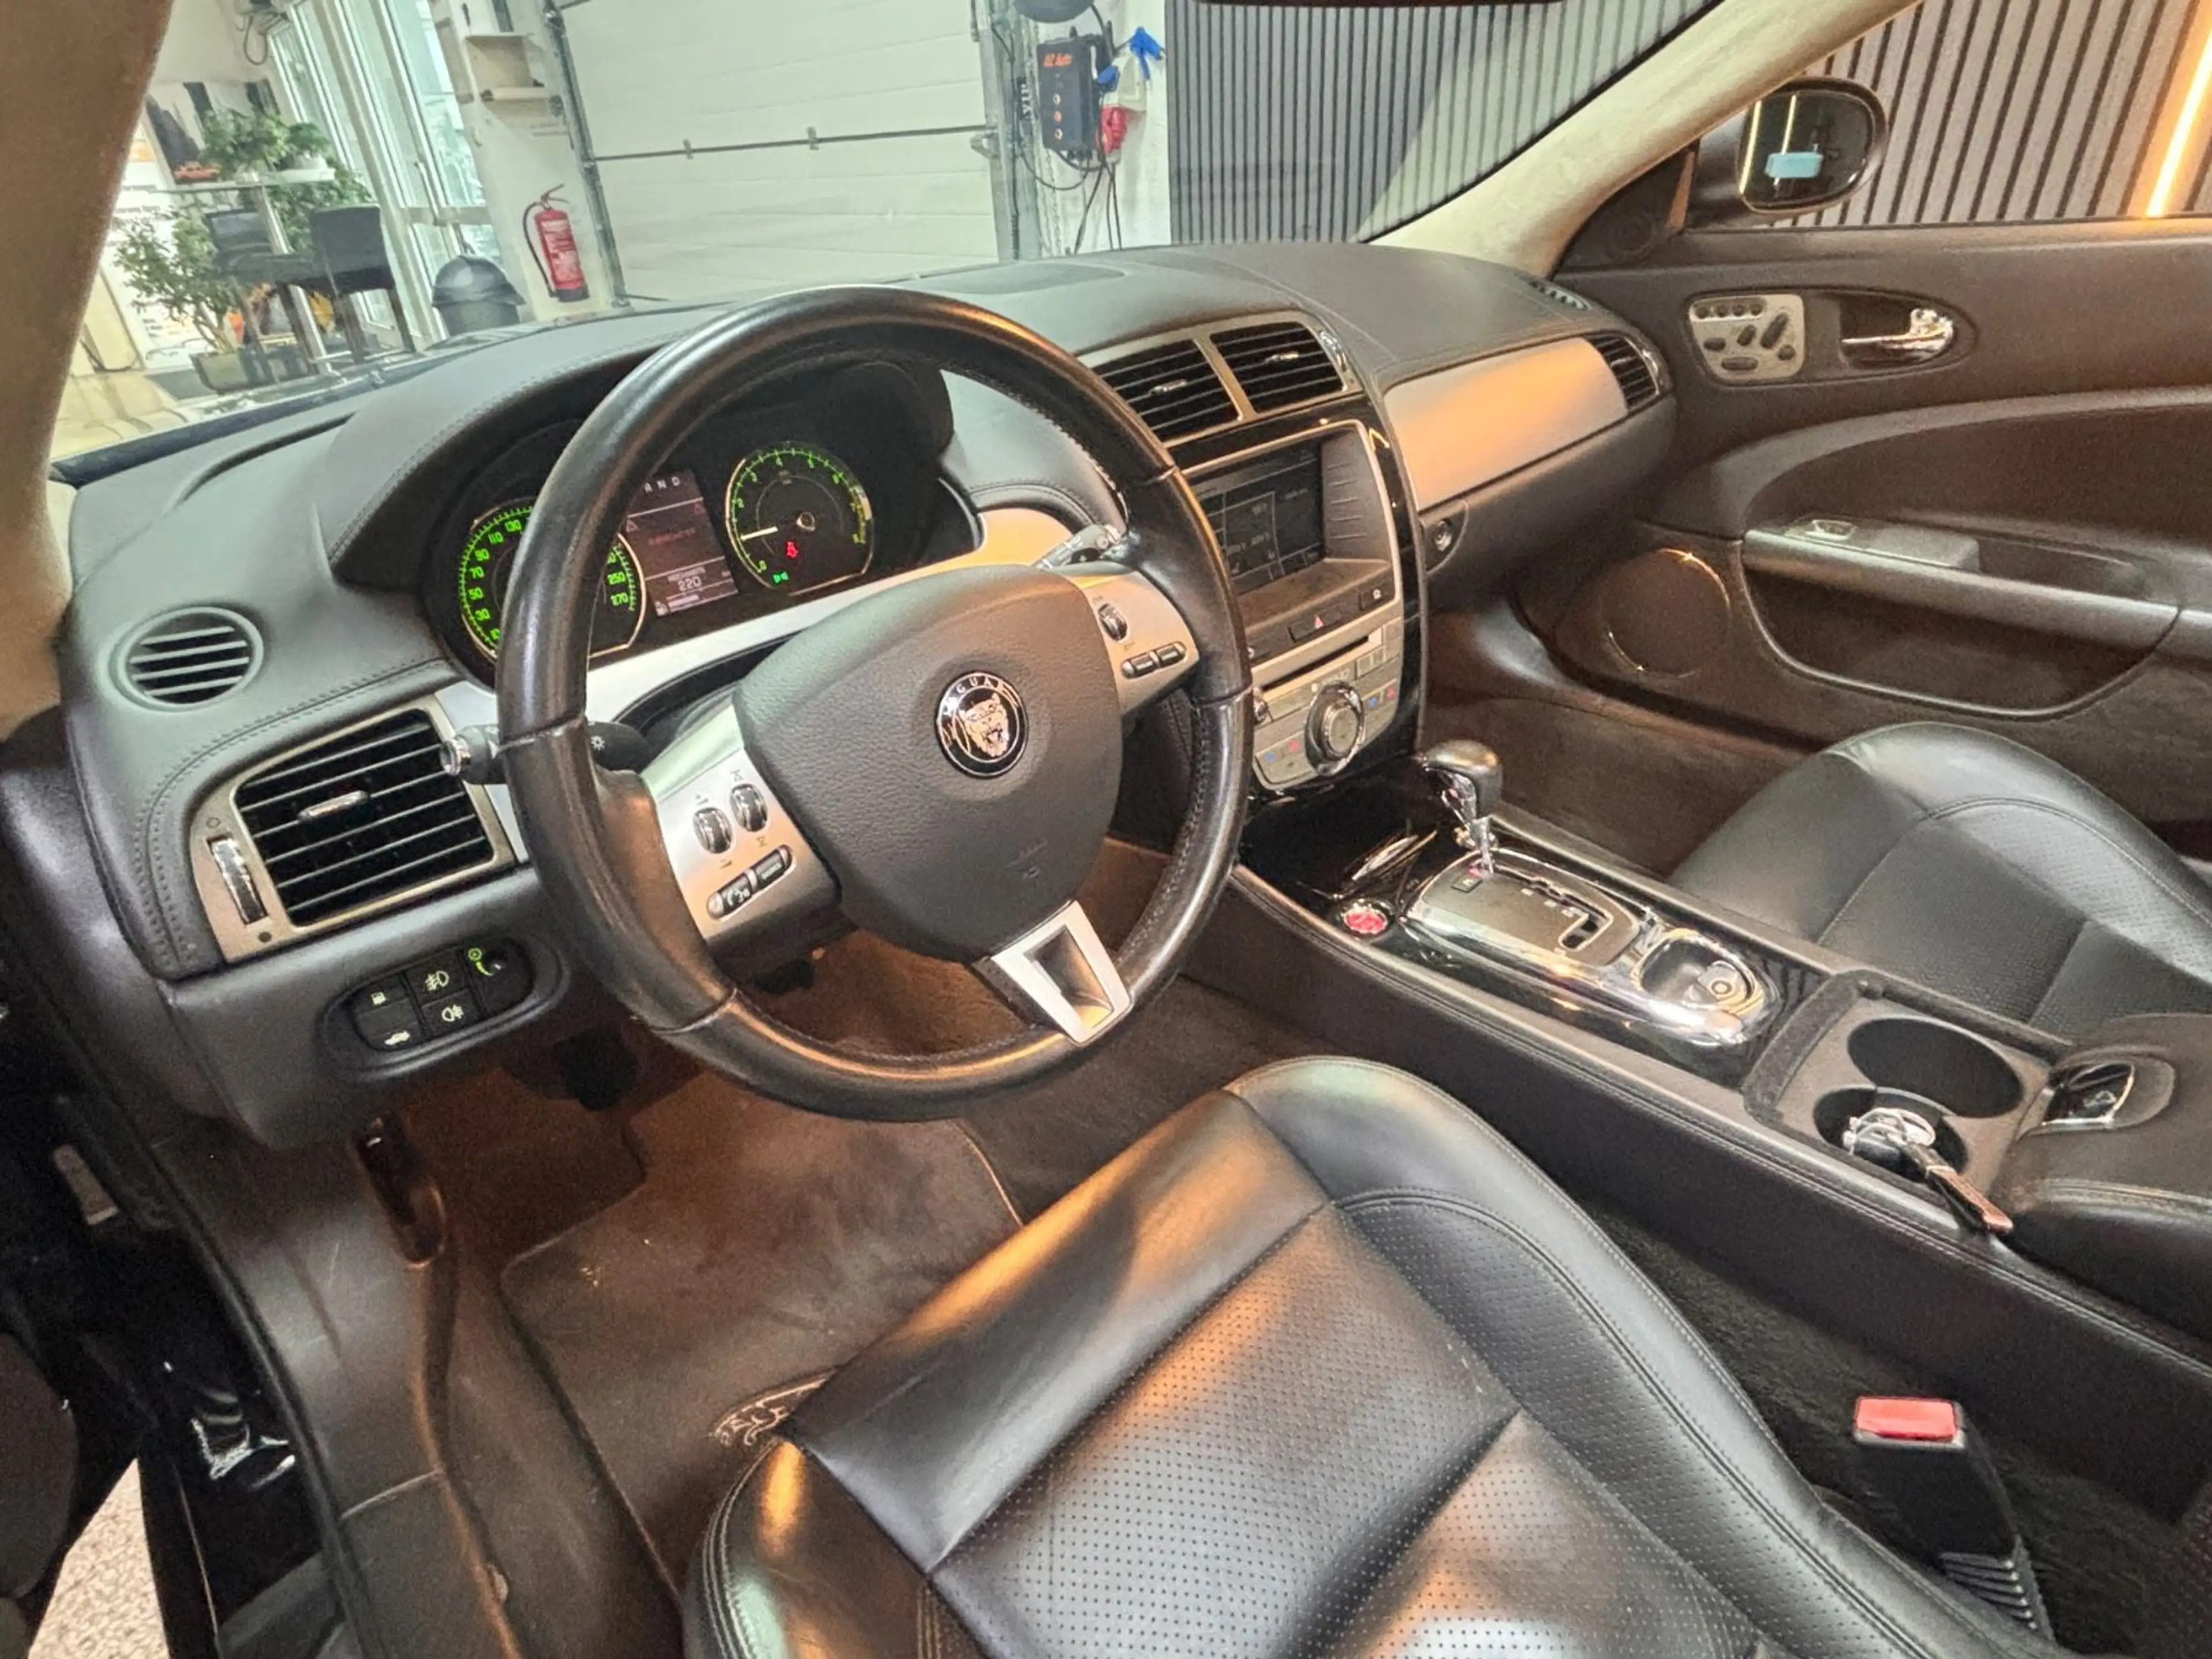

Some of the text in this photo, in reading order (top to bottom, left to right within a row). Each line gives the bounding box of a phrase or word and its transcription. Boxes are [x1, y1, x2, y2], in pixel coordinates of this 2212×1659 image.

[475, 548, 490, 561] 90
[469, 567, 485, 579] 70
[677, 576, 702, 592] 220
[468, 586, 483, 600] 50
[475, 608, 490, 621] 30
[942, 675, 1006, 718] GUA
